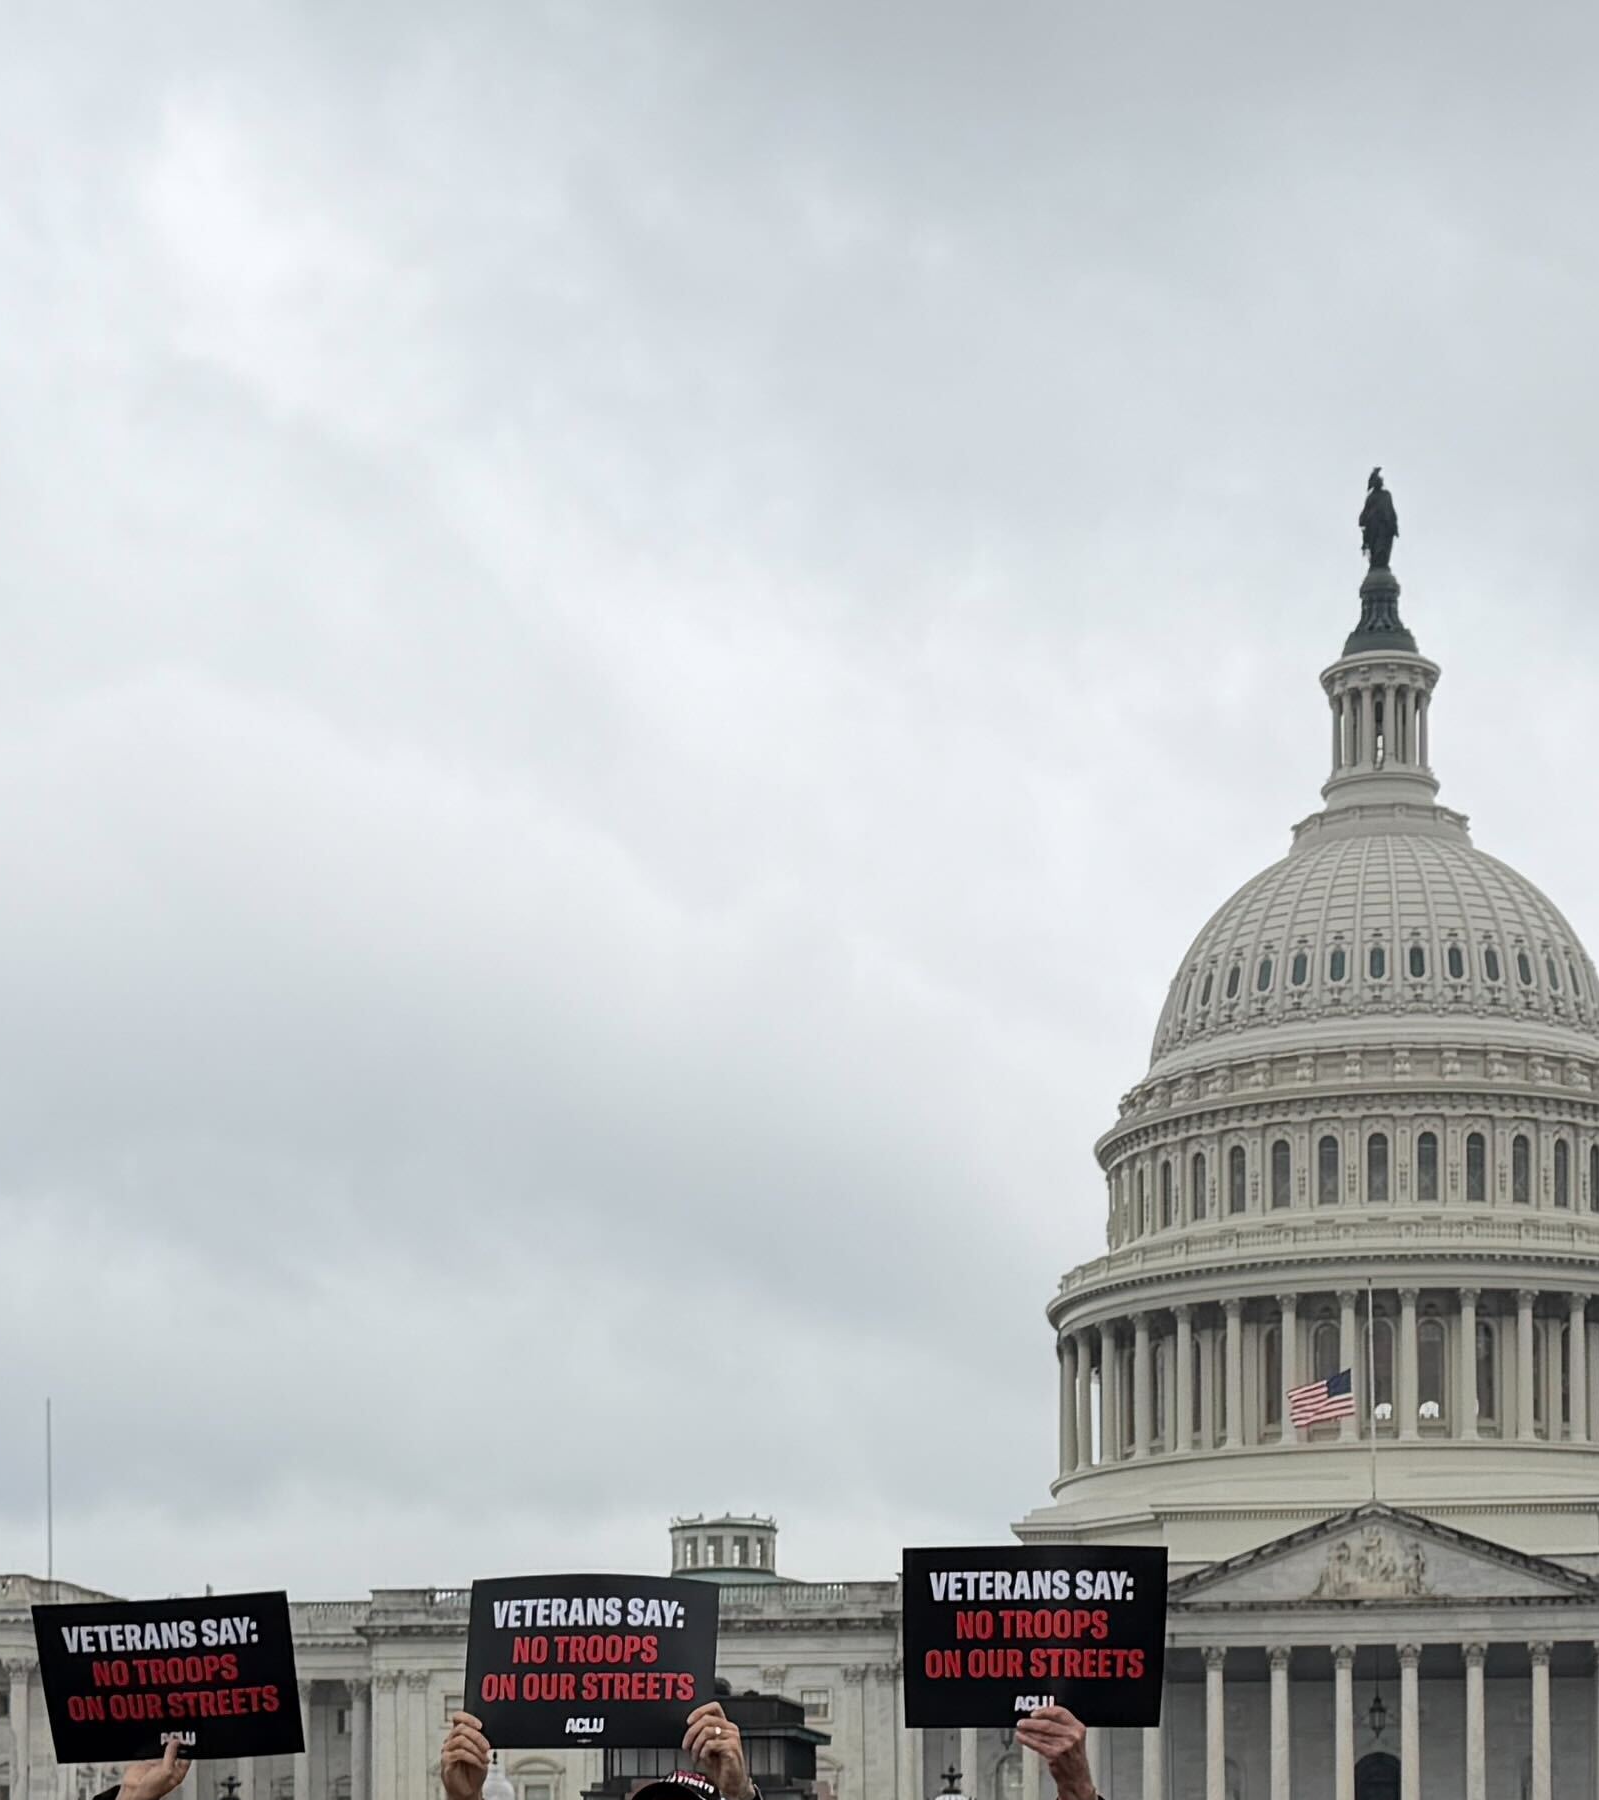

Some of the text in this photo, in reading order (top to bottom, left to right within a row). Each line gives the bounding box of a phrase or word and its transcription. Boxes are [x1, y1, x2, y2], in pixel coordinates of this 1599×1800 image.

[930, 1570, 1133, 1601] VETERANS SAY:
[493, 1598, 684, 1628] VETERANS SAY:
[957, 1609, 1109, 1640] NO TROOPS
[62, 1616, 258, 1653] VETERANS SAY:
[513, 1635, 658, 1664] NO TROOPS
[92, 1654, 239, 1687] NO TROOPS
[925, 1649, 1145, 1678] ON OUR STREETS
[481, 1672, 695, 1702] ON OUR STREETS
[68, 1685, 280, 1721] ON OUR STREETS
[565, 1718, 604, 1733] ACLU
